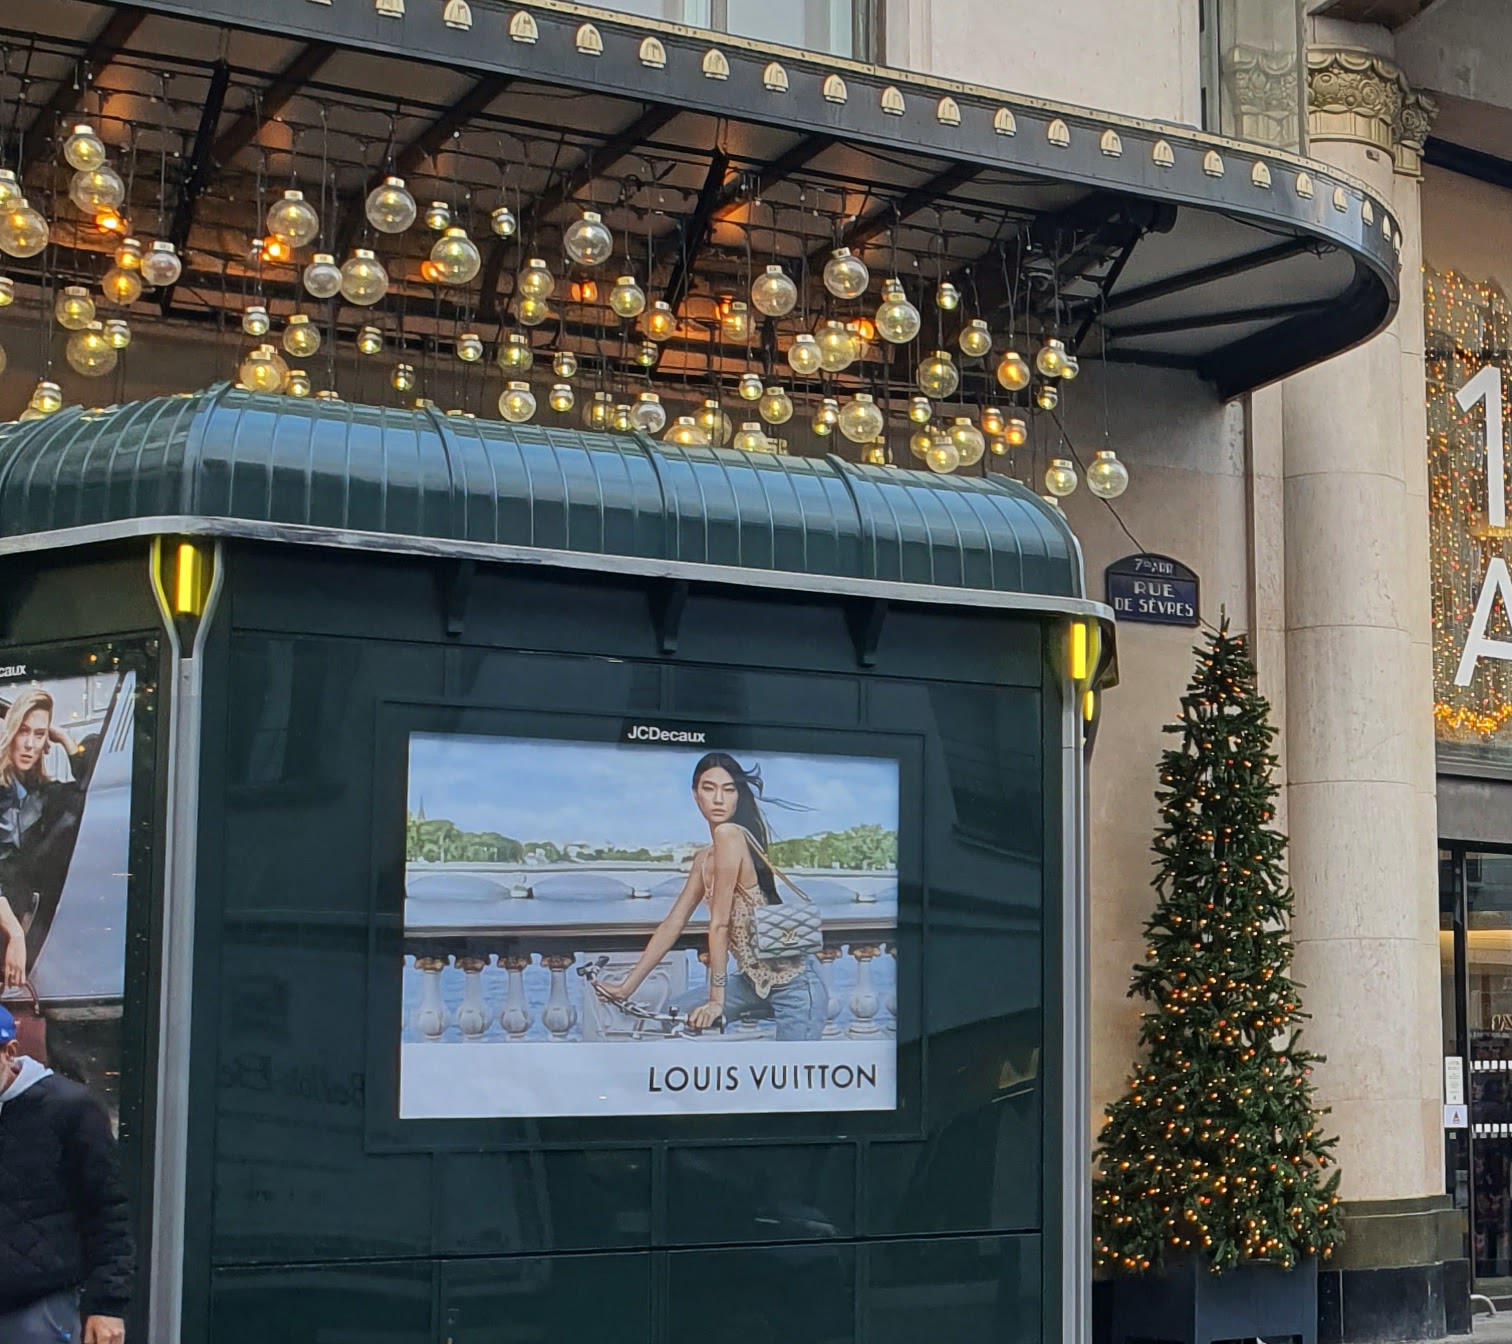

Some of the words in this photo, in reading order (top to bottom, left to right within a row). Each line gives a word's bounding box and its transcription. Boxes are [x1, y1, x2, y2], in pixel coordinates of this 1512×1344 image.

[1133, 580, 1175, 598] RUE
[1114, 597, 1134, 612] DE
[1139, 597, 1194, 617] SÈVRES
[628, 725, 706, 743] JCDecaux
[648, 1066, 739, 1092] LOUIS
[750, 1064, 877, 1091] VUITTON
